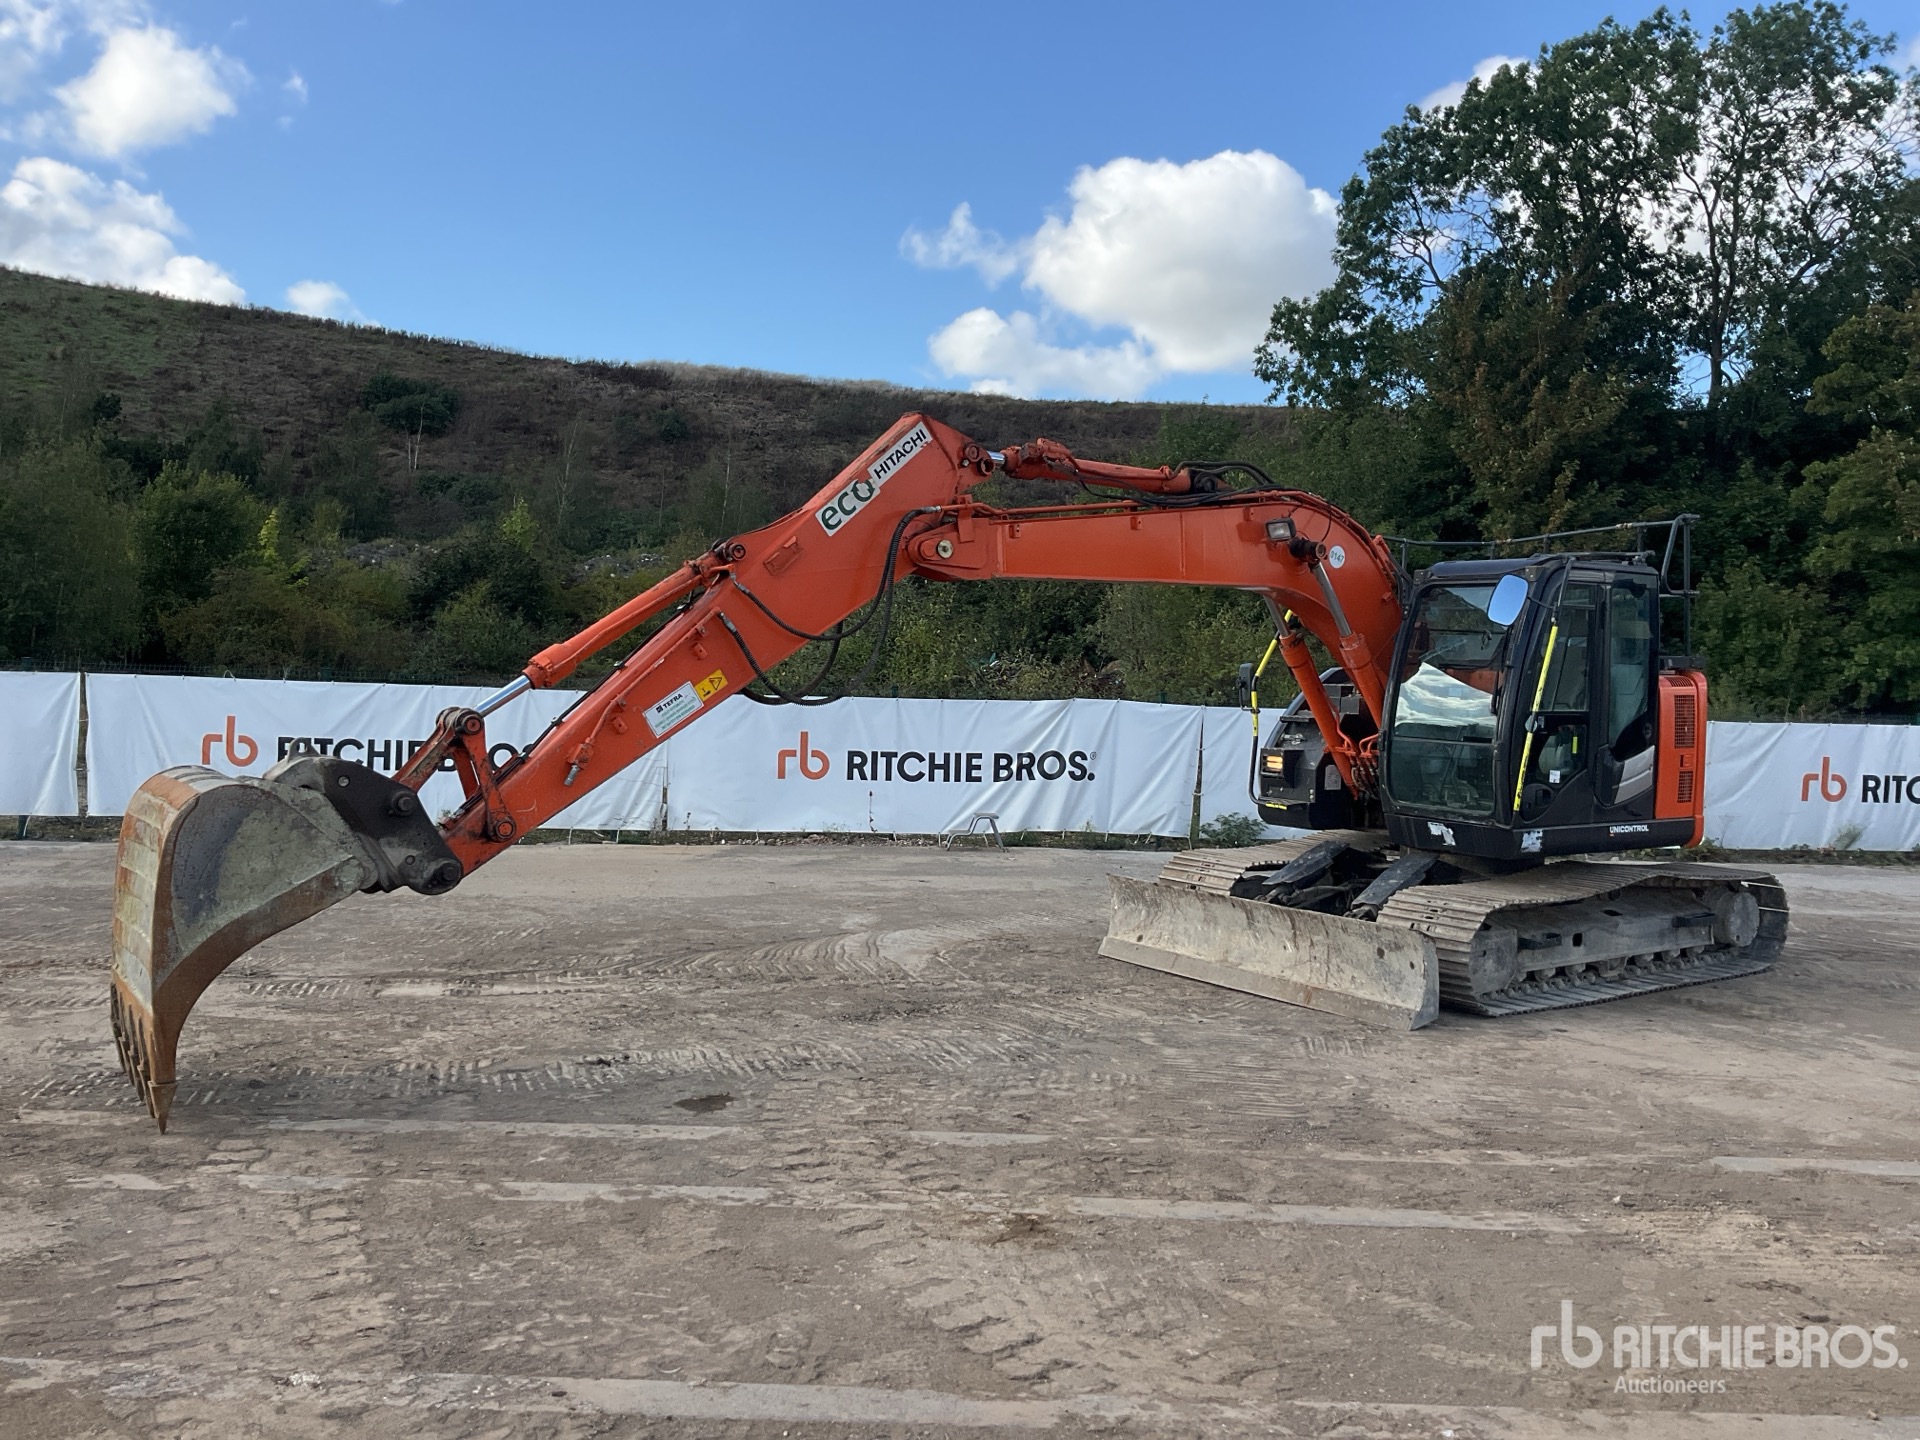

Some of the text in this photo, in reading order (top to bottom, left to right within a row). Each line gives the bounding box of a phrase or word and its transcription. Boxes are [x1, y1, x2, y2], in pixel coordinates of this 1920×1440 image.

[874, 429, 927, 480] HITACHI
[821, 479, 876, 530] eco
[662, 693, 684, 709] TEFRA
[201, 715, 259, 768] rb
[777, 731, 1096, 783] rb RITCHIE BROS.
[1801, 756, 1848, 803] rb
[1609, 824, 1650, 834] UNICONTROL
